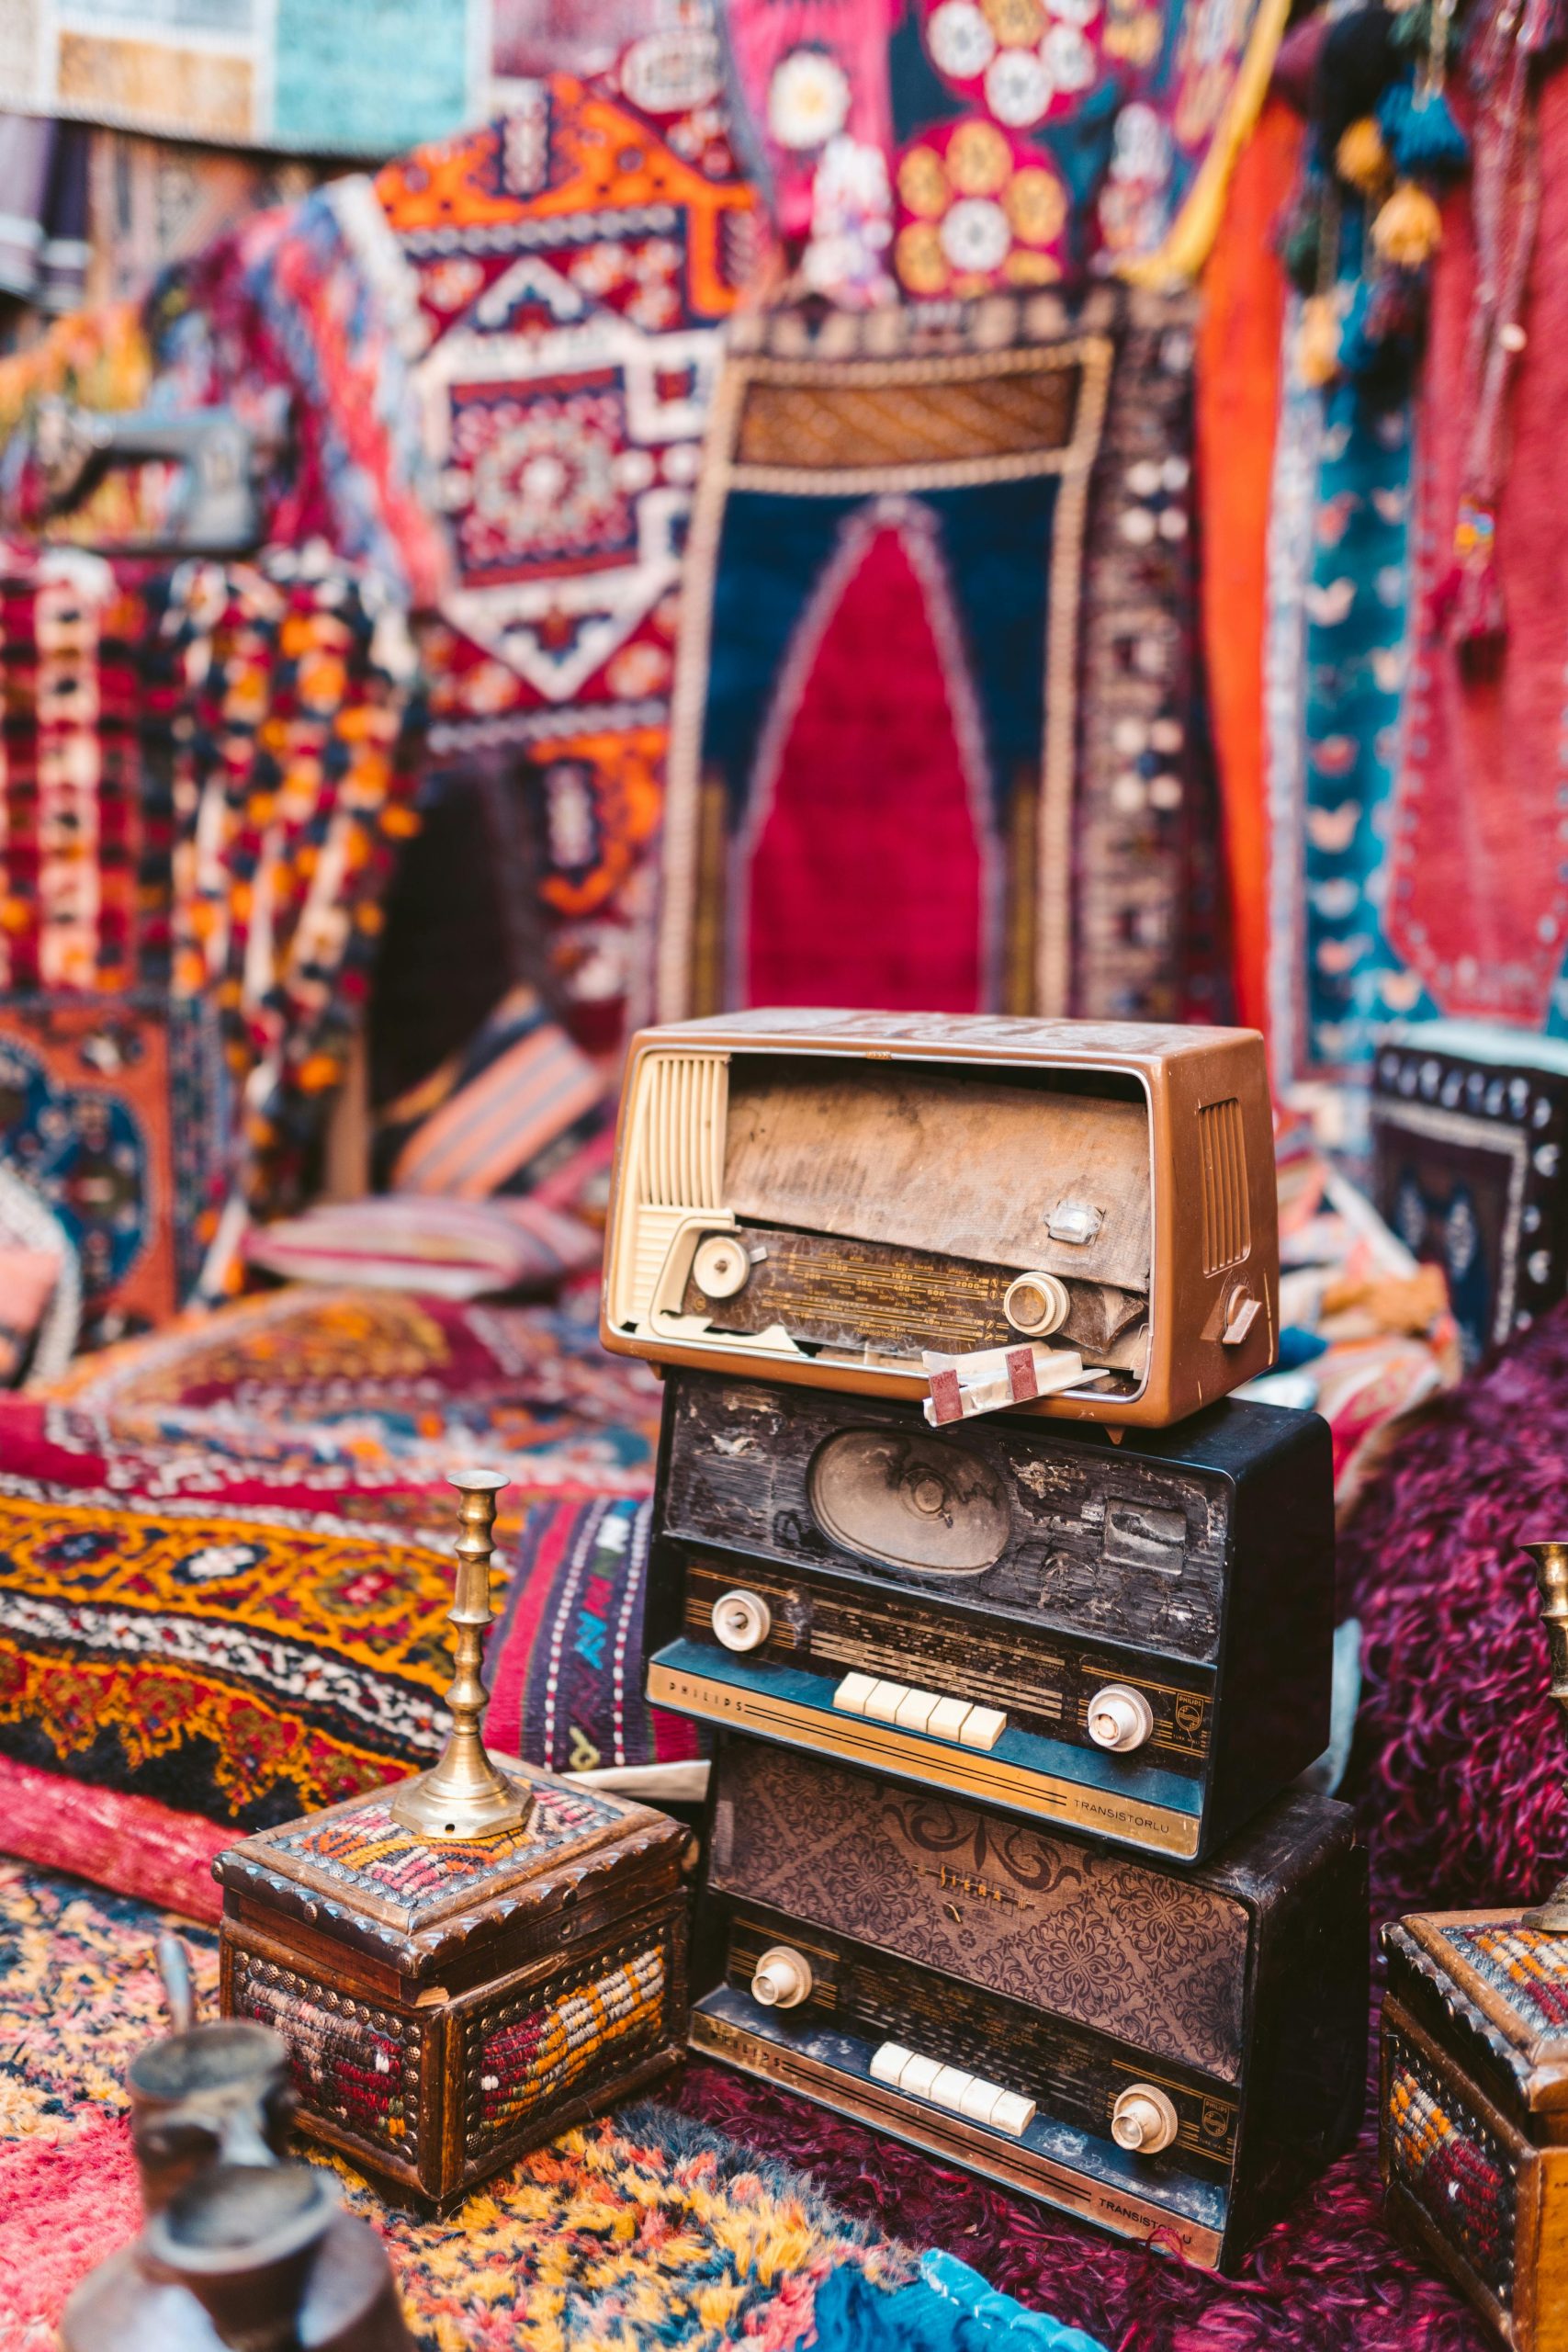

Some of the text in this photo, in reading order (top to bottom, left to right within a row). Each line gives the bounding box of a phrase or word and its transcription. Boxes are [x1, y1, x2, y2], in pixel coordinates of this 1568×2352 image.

[804, 1272, 821, 1281] 200
[855, 1279, 874, 1287] 300
[893, 1284, 910, 1293] 400
[927, 1288, 945, 1297] 500
[827, 1263, 849, 1272] 1000
[891, 1272, 913, 1281] 1500
[955, 1281, 980, 1290] 2000
[669, 1681, 742, 1712] PHILIPS
[1179, 1695, 1202, 1707] PHILIPS
[1073, 1799, 1170, 1834] TRANSISTORLU
[1205, 2100, 1228, 2114] PHILIPS
